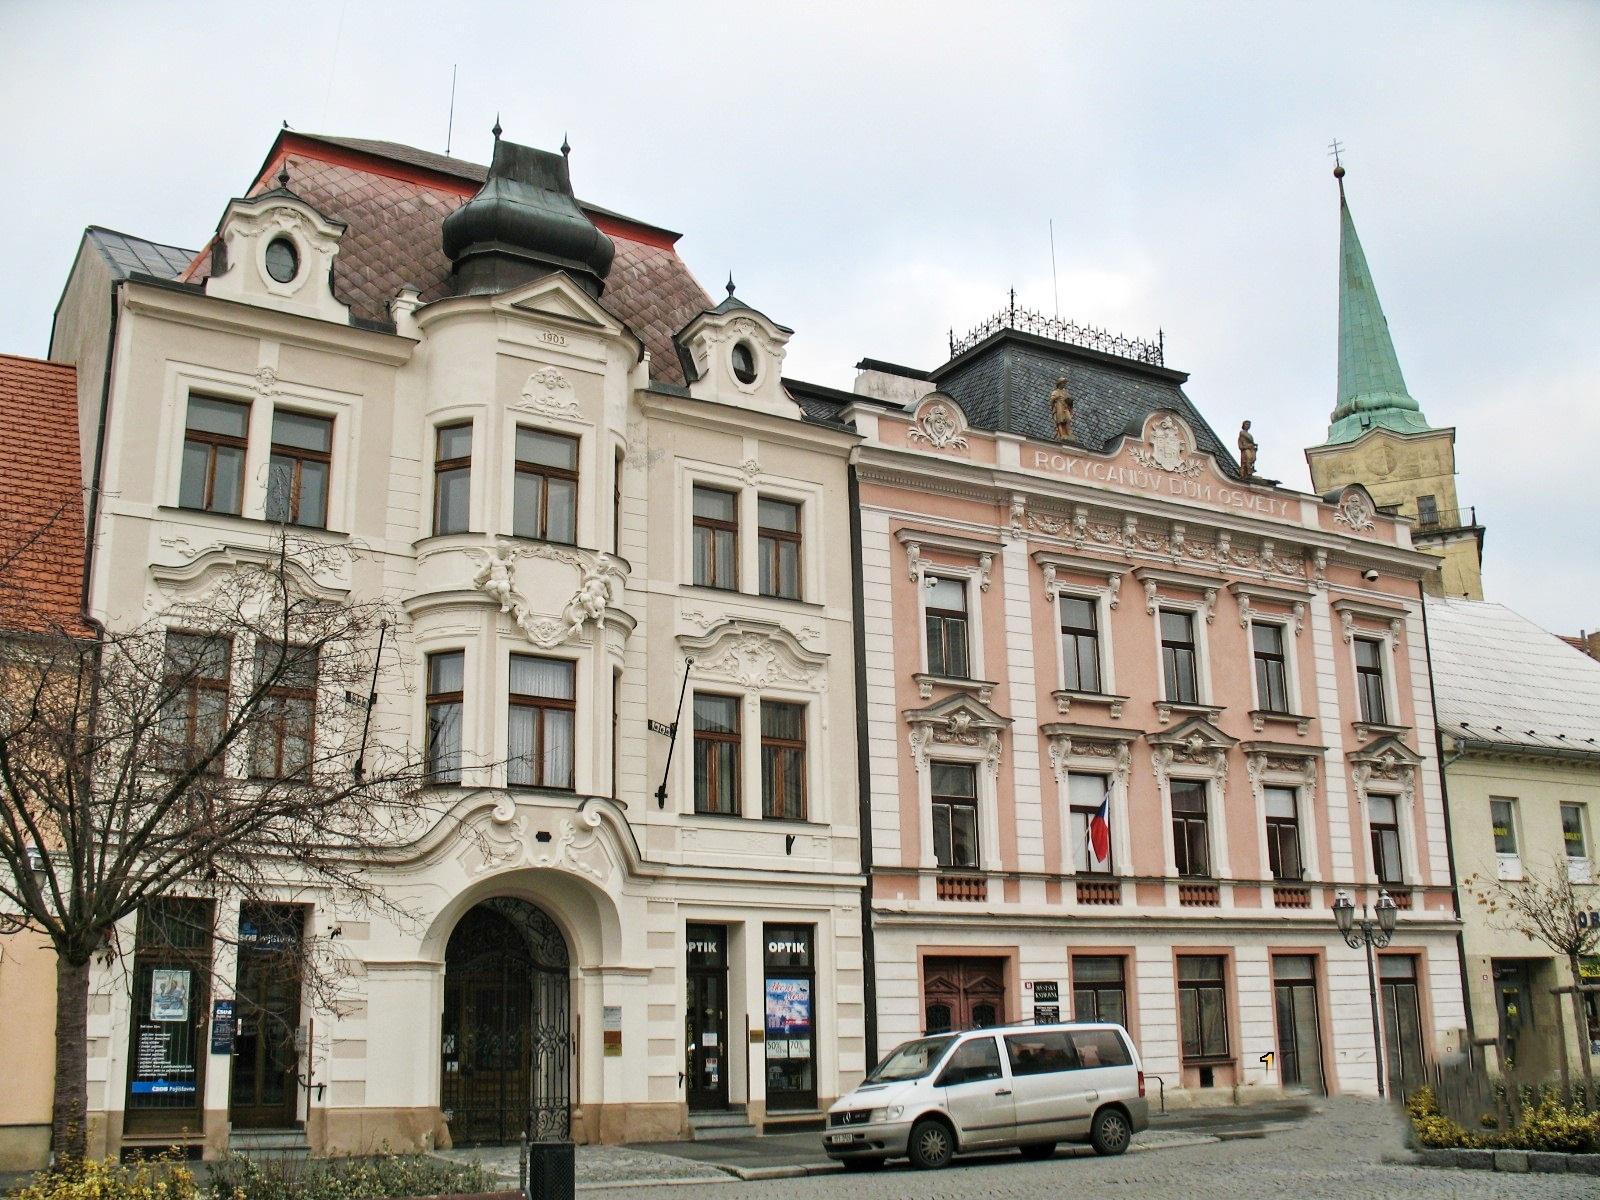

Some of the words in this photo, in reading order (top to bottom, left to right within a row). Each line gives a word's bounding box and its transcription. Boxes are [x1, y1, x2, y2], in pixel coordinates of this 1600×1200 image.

[543, 332, 564, 344] 1903
[1034, 451, 1162, 491] ROKYCANŮV
[1168, 477, 1211, 501] DŮM
[686, 942, 717, 953] PTIK
[768, 942, 805, 953] OPTIK
